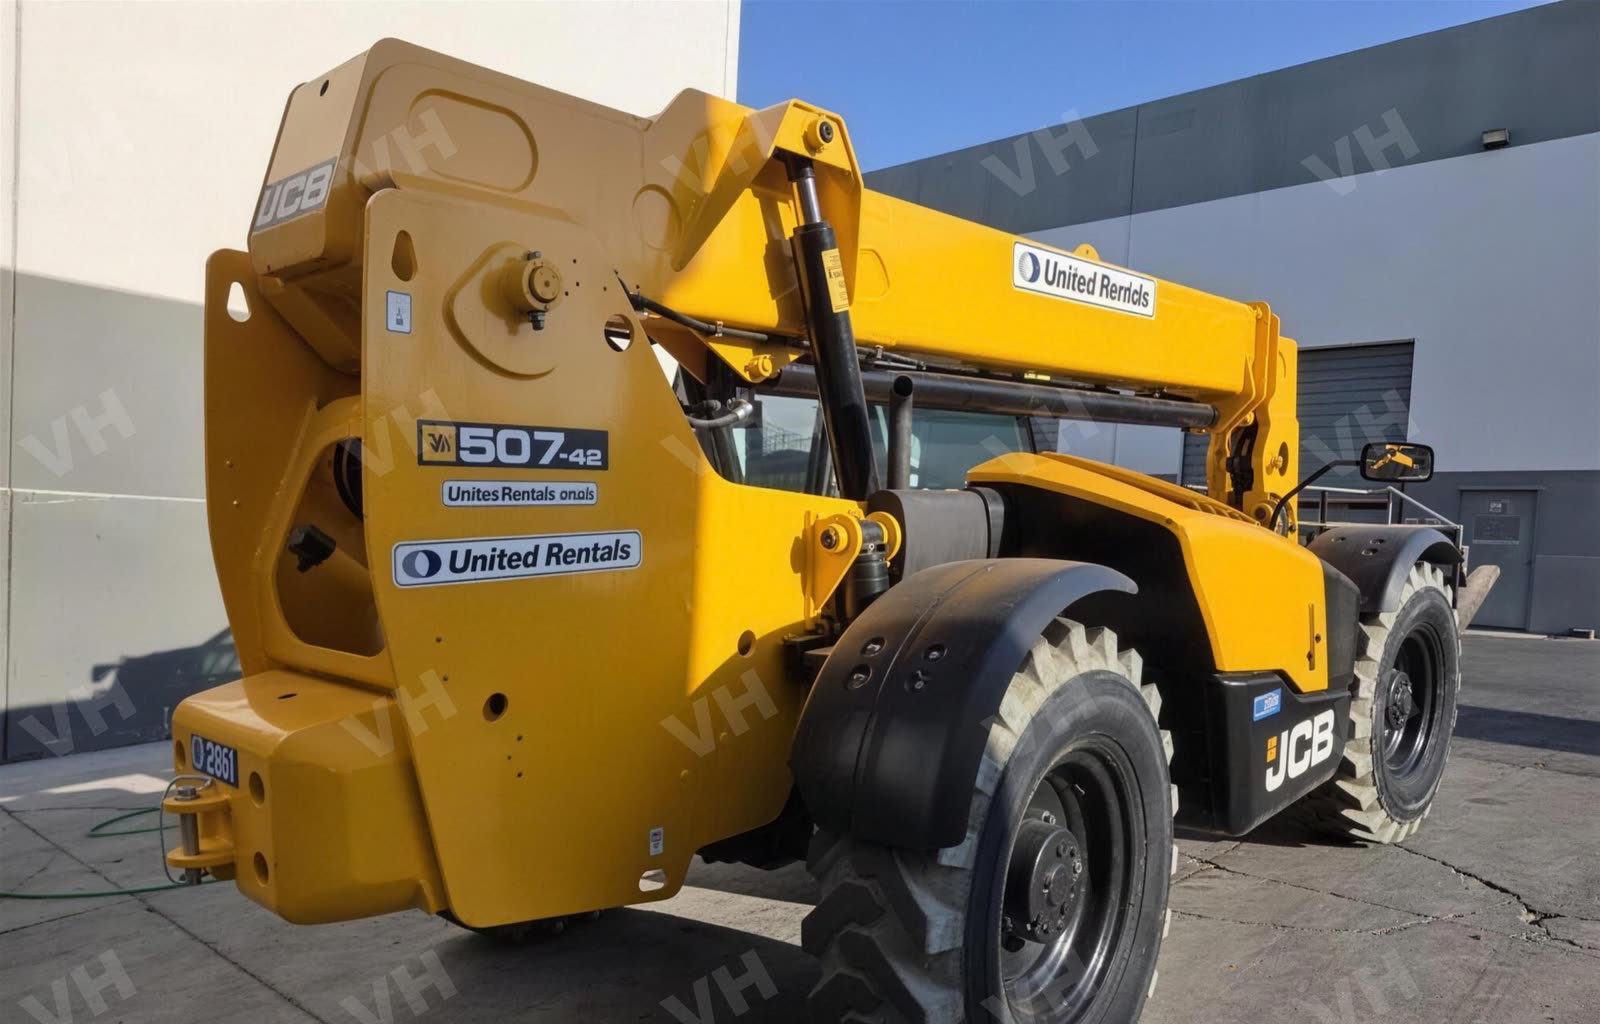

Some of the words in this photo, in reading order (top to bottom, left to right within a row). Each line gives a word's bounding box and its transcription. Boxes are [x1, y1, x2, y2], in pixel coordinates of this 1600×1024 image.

[1044, 258, 1097, 296] United
[459, 426, 602, 466] 507-42
[448, 486, 499, 502] Unites
[501, 486, 556, 502] Rentals
[450, 544, 540, 573] United
[545, 539, 631, 566] Rentals
[206, 741, 234, 783] 2861
[1265, 709, 1335, 792] JCB
